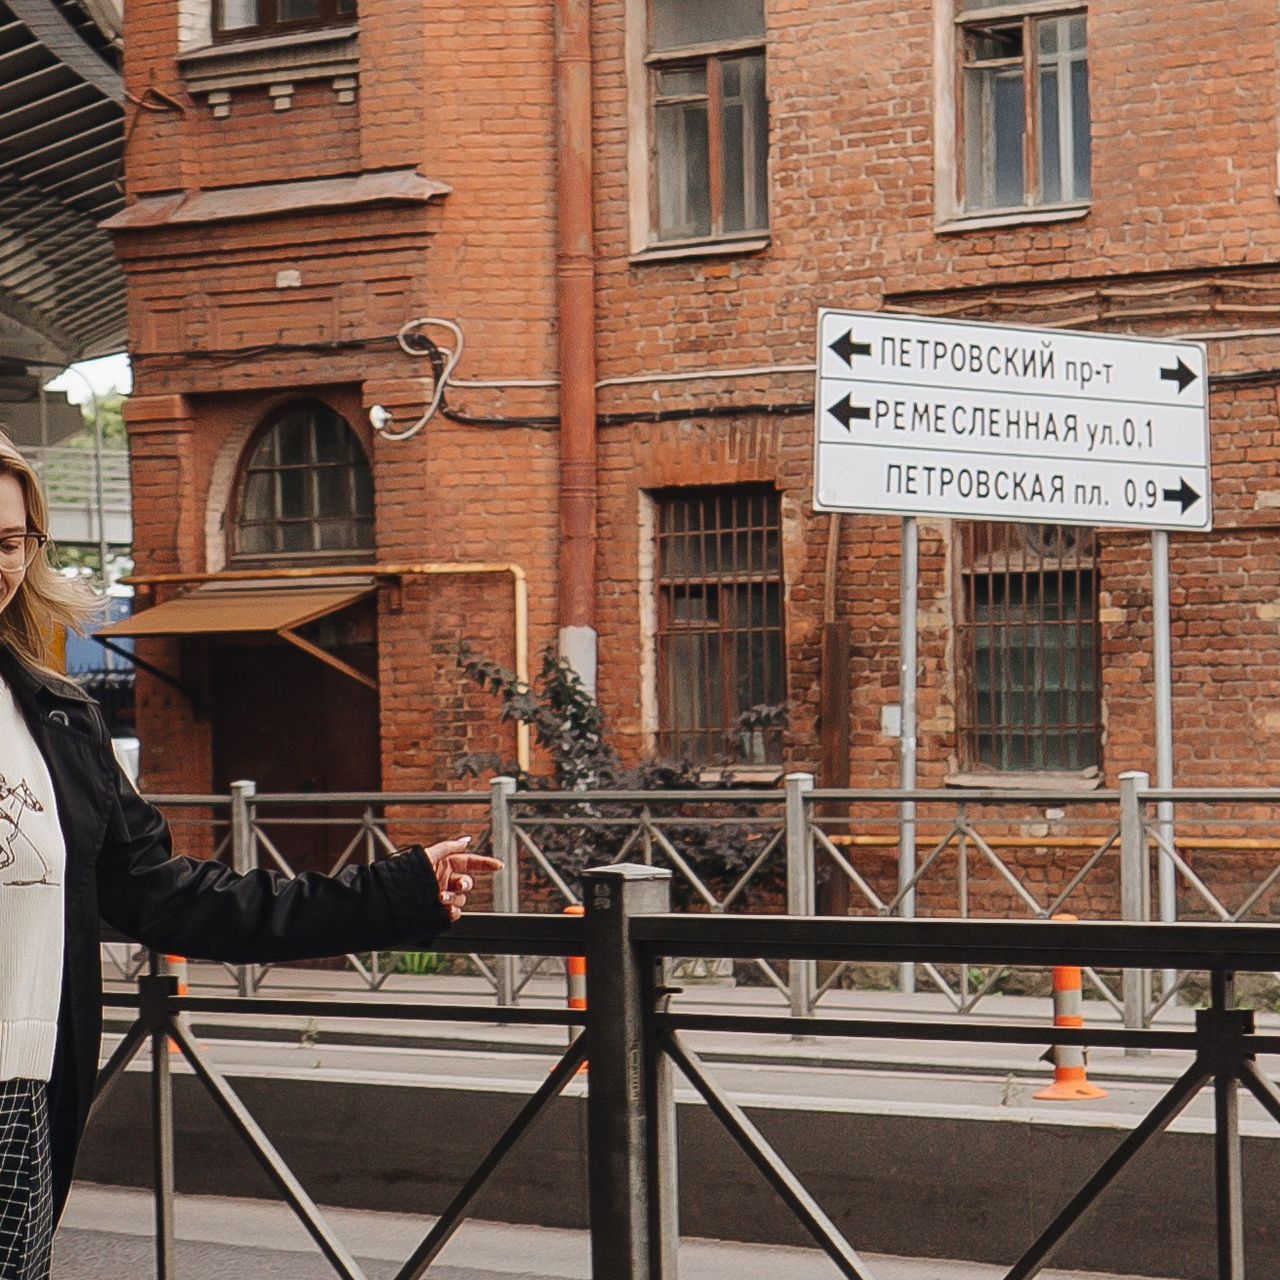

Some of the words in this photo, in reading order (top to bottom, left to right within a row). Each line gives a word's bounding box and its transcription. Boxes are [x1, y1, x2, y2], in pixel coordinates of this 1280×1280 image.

[881, 336, 1055, 380] ПЕТРОВСКИЙ
[1065, 360, 1114, 391] пр-т
[874, 399, 1079, 443] РЕМЕСЛЕННАЯ
[885, 463, 1065, 504] ПЕТРОВСКАЯ
[1074, 483, 1110, 507] пл.
[1124, 478, 1158, 511] 0,9
